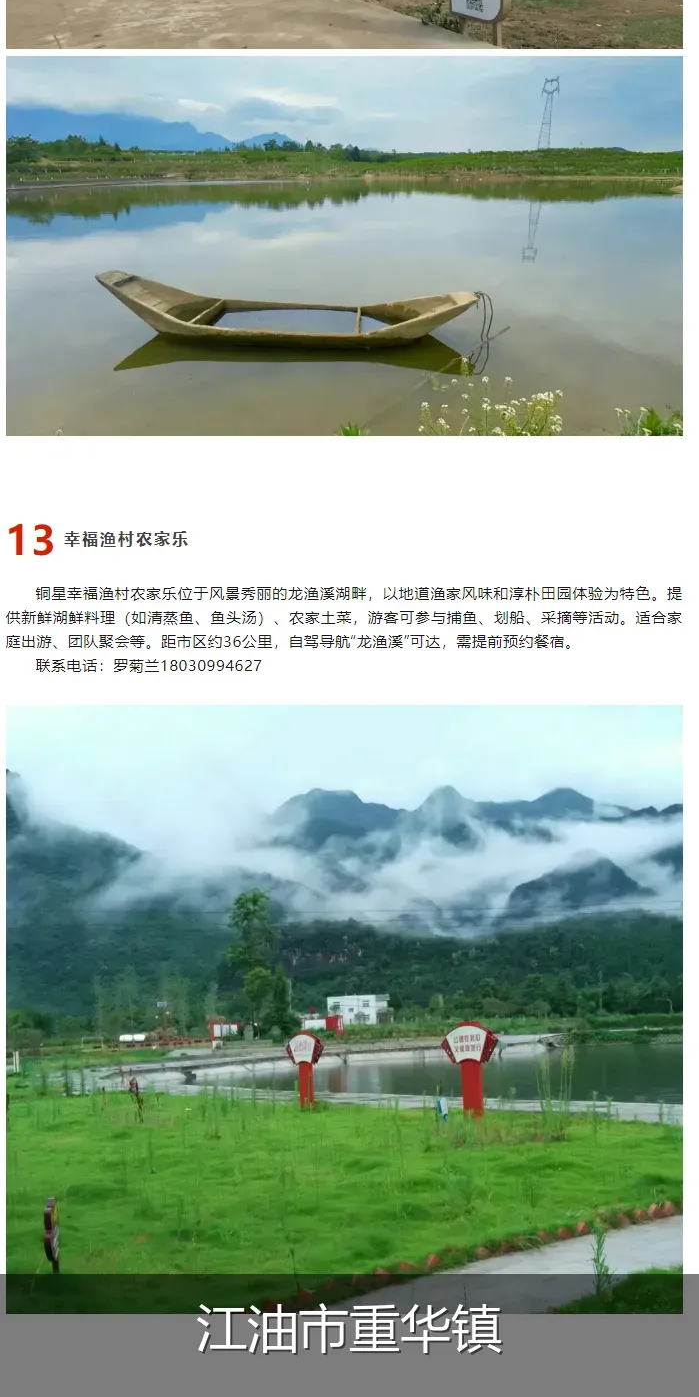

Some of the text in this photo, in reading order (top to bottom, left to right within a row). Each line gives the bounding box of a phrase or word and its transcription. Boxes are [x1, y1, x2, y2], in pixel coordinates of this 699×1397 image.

[9, 524, 188, 556] 13 幸福渔村农家乐
[36, 586, 682, 601] 铜星幸福渔村农家乐位于风景秀丽的龙渔溪湖畔，以地道渔家风味和淳朴田园体验为特色。提
[6, 610, 682, 626] 供新鲜湖鲜料理（如清蒸鱼、鱼头汤）、农家土菜，游客可参与捕鱼、划船、采摘等活动。适合家
[36, 659, 261, 673] 联系电话：罗菊兰18030994627
